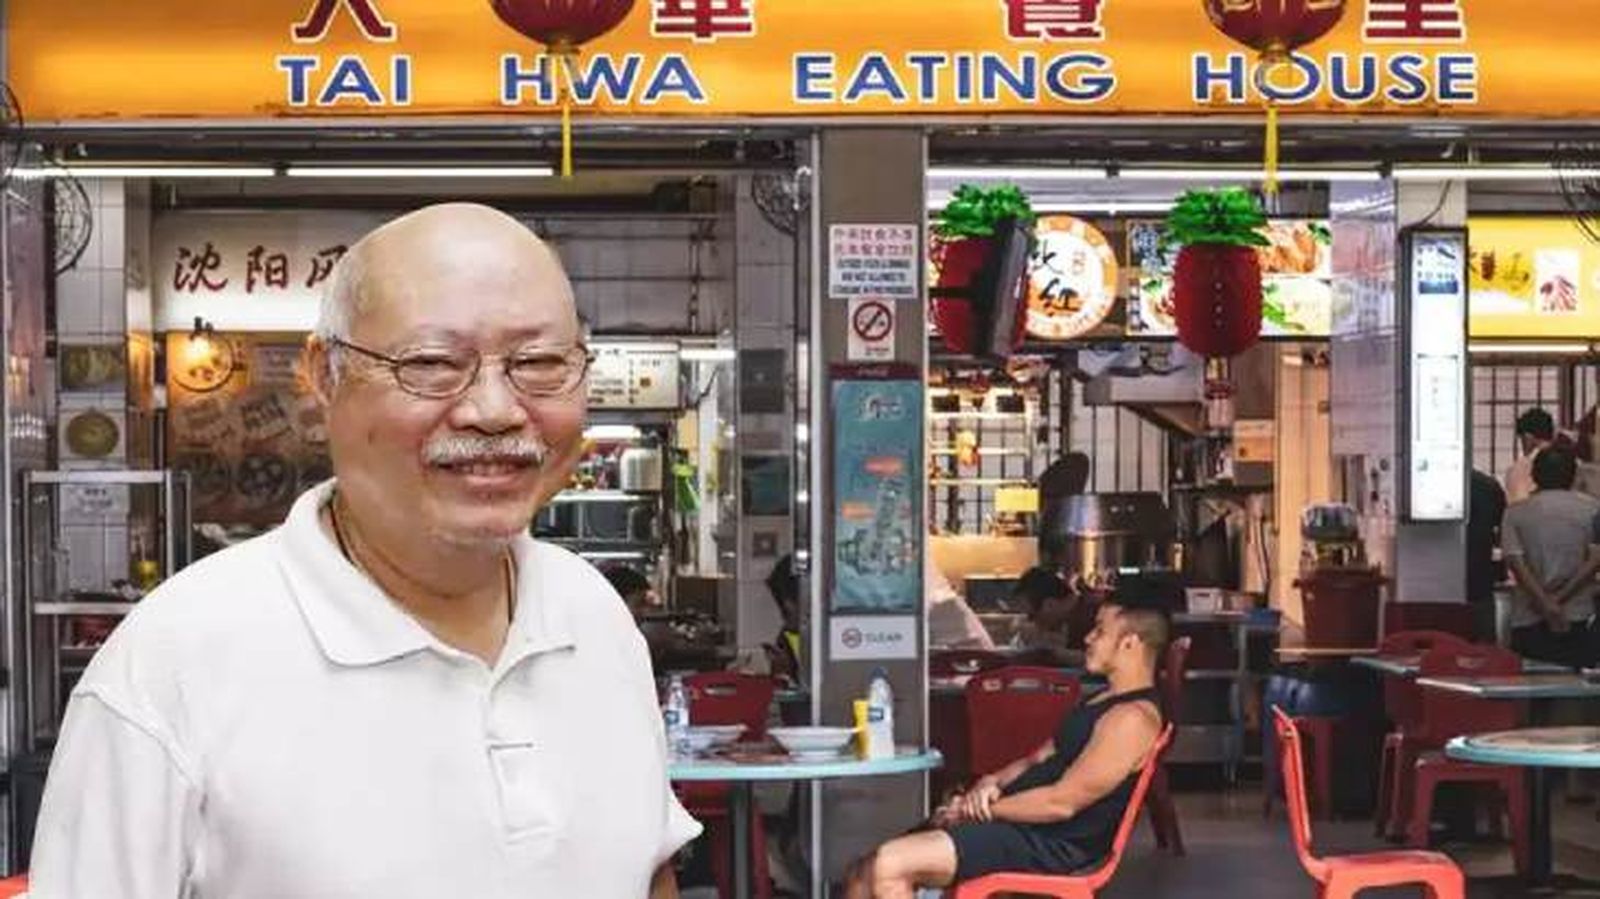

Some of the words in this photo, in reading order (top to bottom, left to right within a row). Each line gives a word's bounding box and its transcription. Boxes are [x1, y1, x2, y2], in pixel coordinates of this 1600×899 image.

[279, 55, 410, 105] TAI
[503, 55, 707, 103] HWA
[794, 54, 1115, 102] EATING
[1195, 54, 1477, 102] HOUSE
